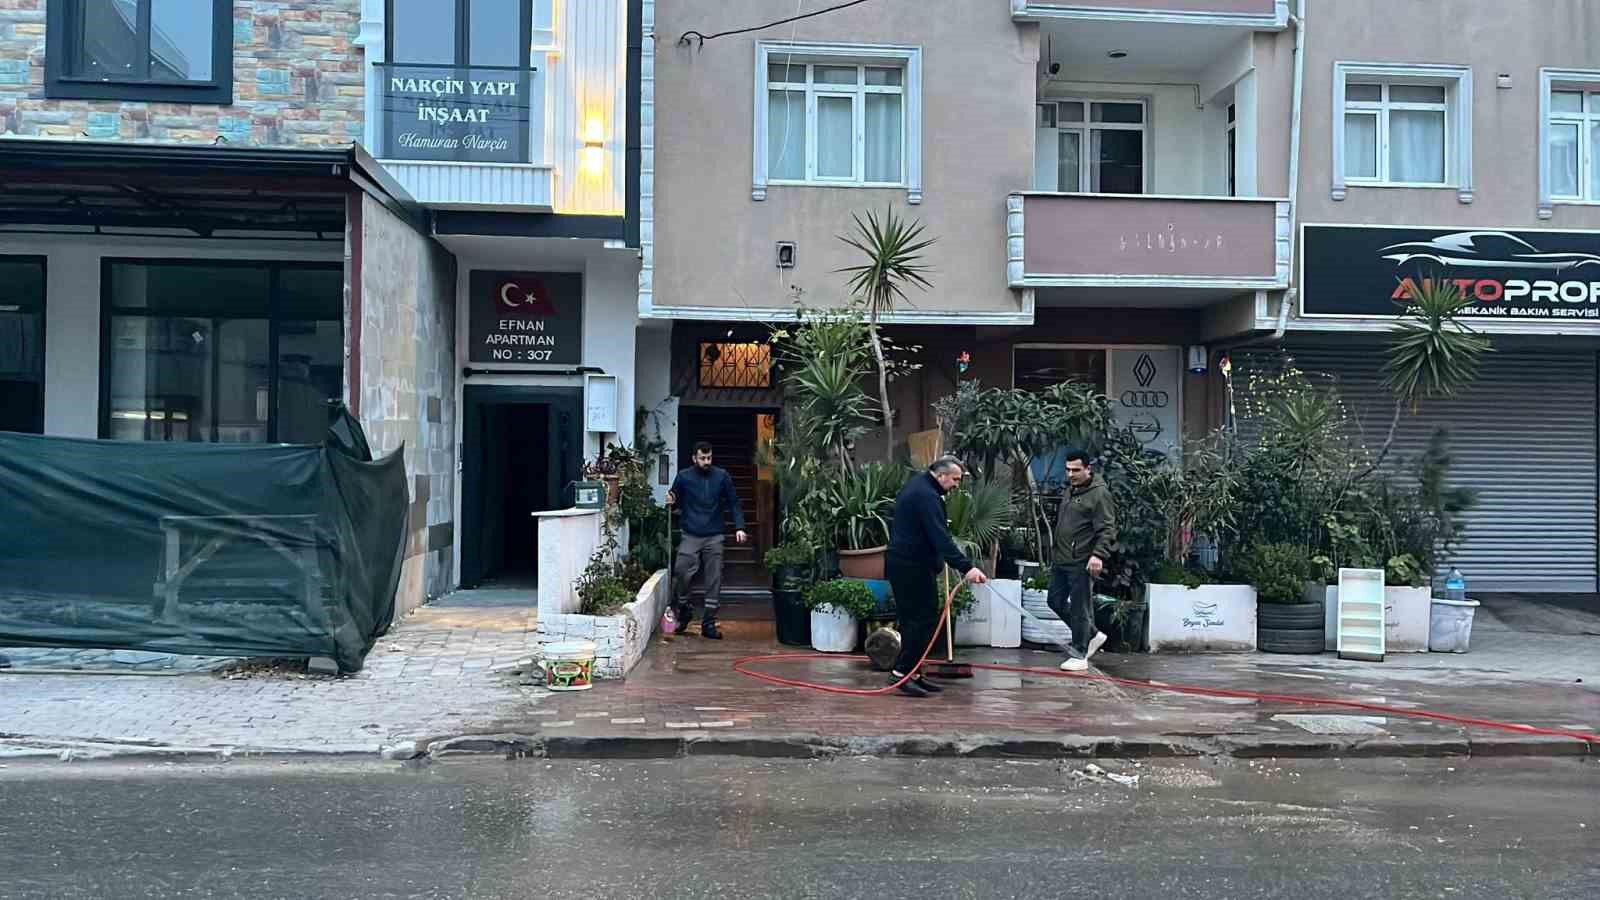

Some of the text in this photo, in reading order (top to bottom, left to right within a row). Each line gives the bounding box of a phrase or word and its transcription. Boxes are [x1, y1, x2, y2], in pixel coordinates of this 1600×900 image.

[391, 77, 518, 97] NARÇİN YAPI
[418, 103, 490, 125] İNŞAAT
[462, 134, 509, 152] Narçin
[1510, 307, 1549, 316] BAKIM
[1552, 307, 1599, 317] SERVİSİ
[499, 319, 544, 332] EFNAN
[485, 334, 555, 346] APARTMAN
[493, 348, 513, 360] NO
[527, 350, 553, 361] 307
